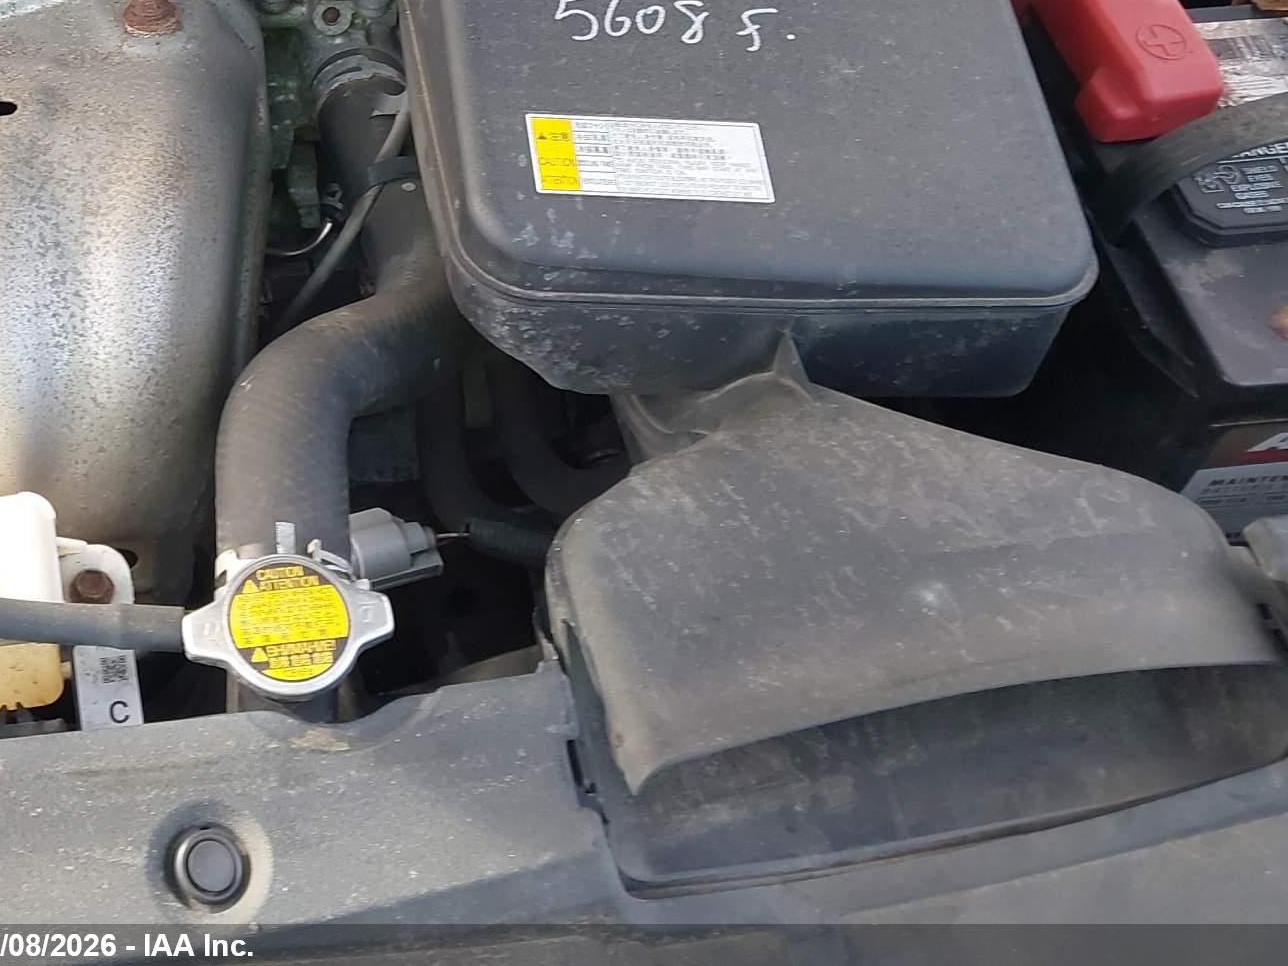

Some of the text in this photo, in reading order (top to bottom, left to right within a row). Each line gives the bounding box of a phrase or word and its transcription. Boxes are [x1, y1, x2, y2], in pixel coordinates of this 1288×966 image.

[256, 565, 304, 581] CAUTION
[259, 575, 320, 591] ATTENTION
[108, 699, 131, 725] C
